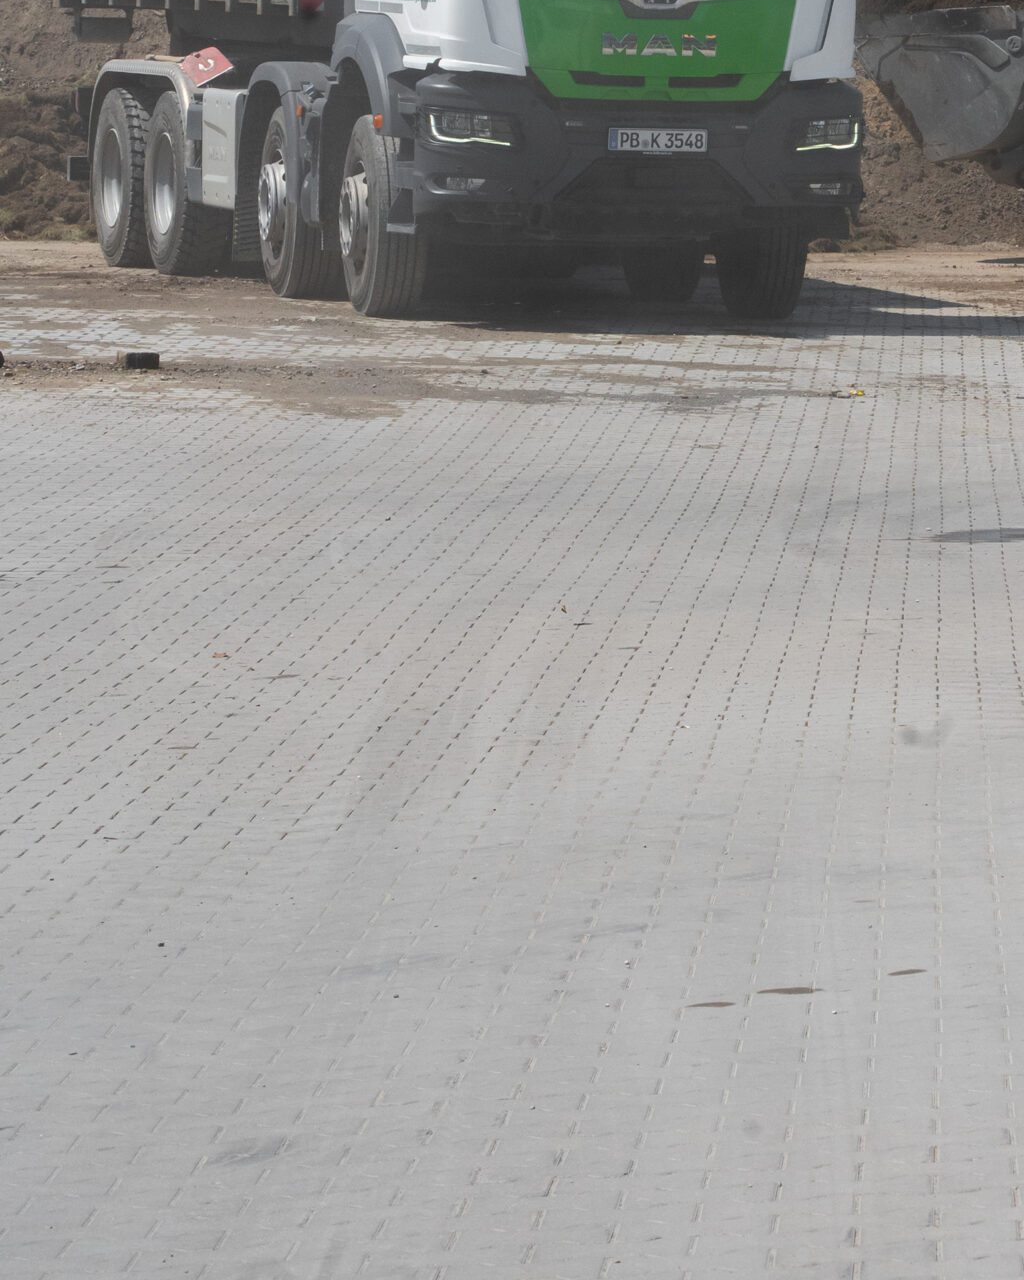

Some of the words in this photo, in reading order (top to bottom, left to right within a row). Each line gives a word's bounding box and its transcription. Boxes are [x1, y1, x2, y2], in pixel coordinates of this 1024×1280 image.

[602, 32, 717, 57] MAN
[620, 132, 640, 149] PB
[650, 132, 662, 149] K
[664, 133, 704, 150] 3548
